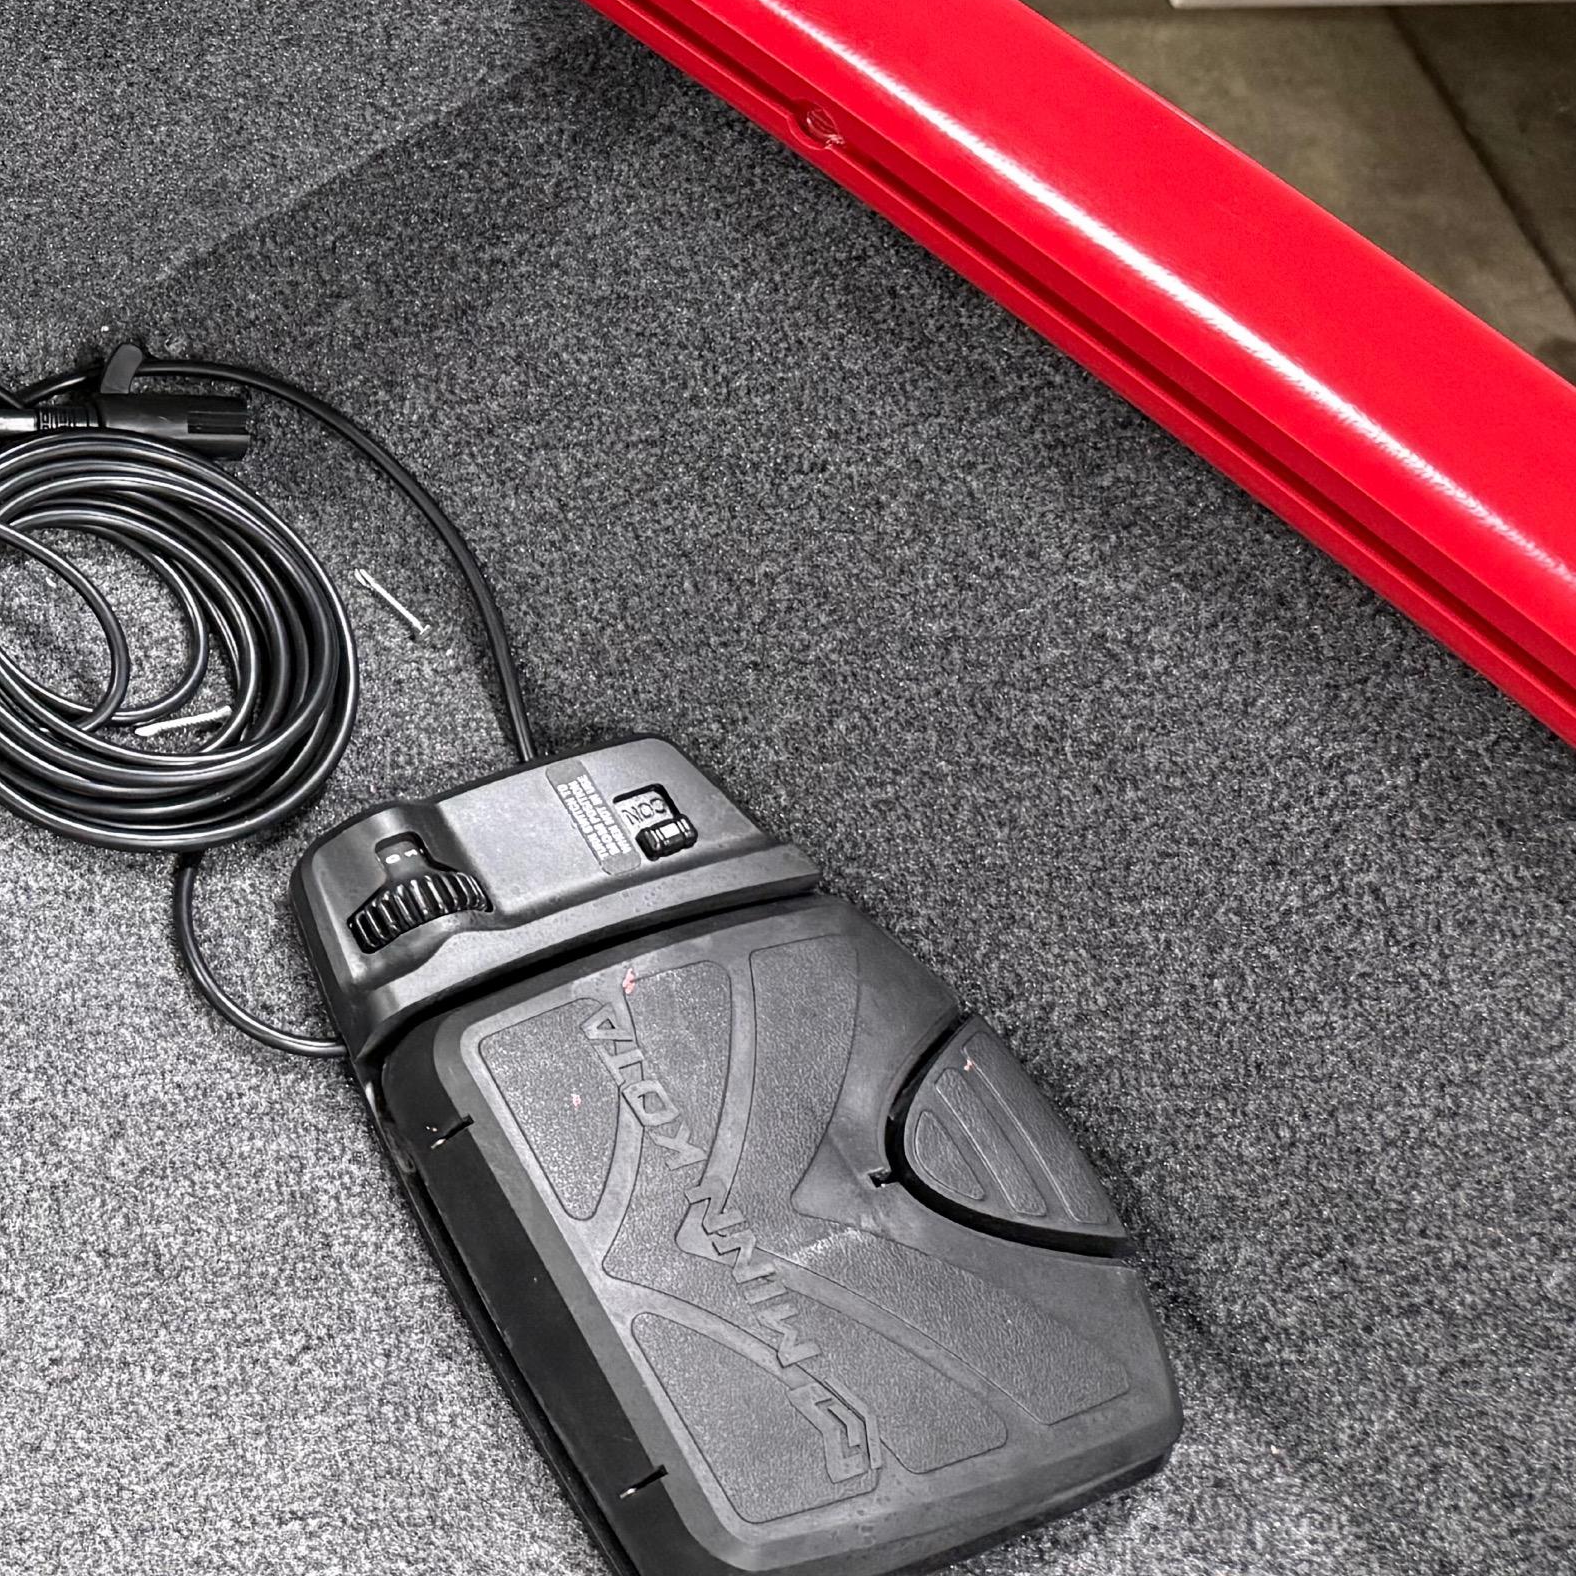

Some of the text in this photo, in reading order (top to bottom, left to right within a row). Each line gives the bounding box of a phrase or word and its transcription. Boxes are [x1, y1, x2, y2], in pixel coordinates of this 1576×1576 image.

[577, 774, 596, 795] USE
[568, 780, 602, 824] POSITION
[595, 805, 615, 826] NOT
[621, 797, 667, 825] CON
[556, 783, 609, 861] TURN SWITCH TO
[608, 824, 632, 854] WHEN
[582, 1000, 822, 1370] MINN KOTA
